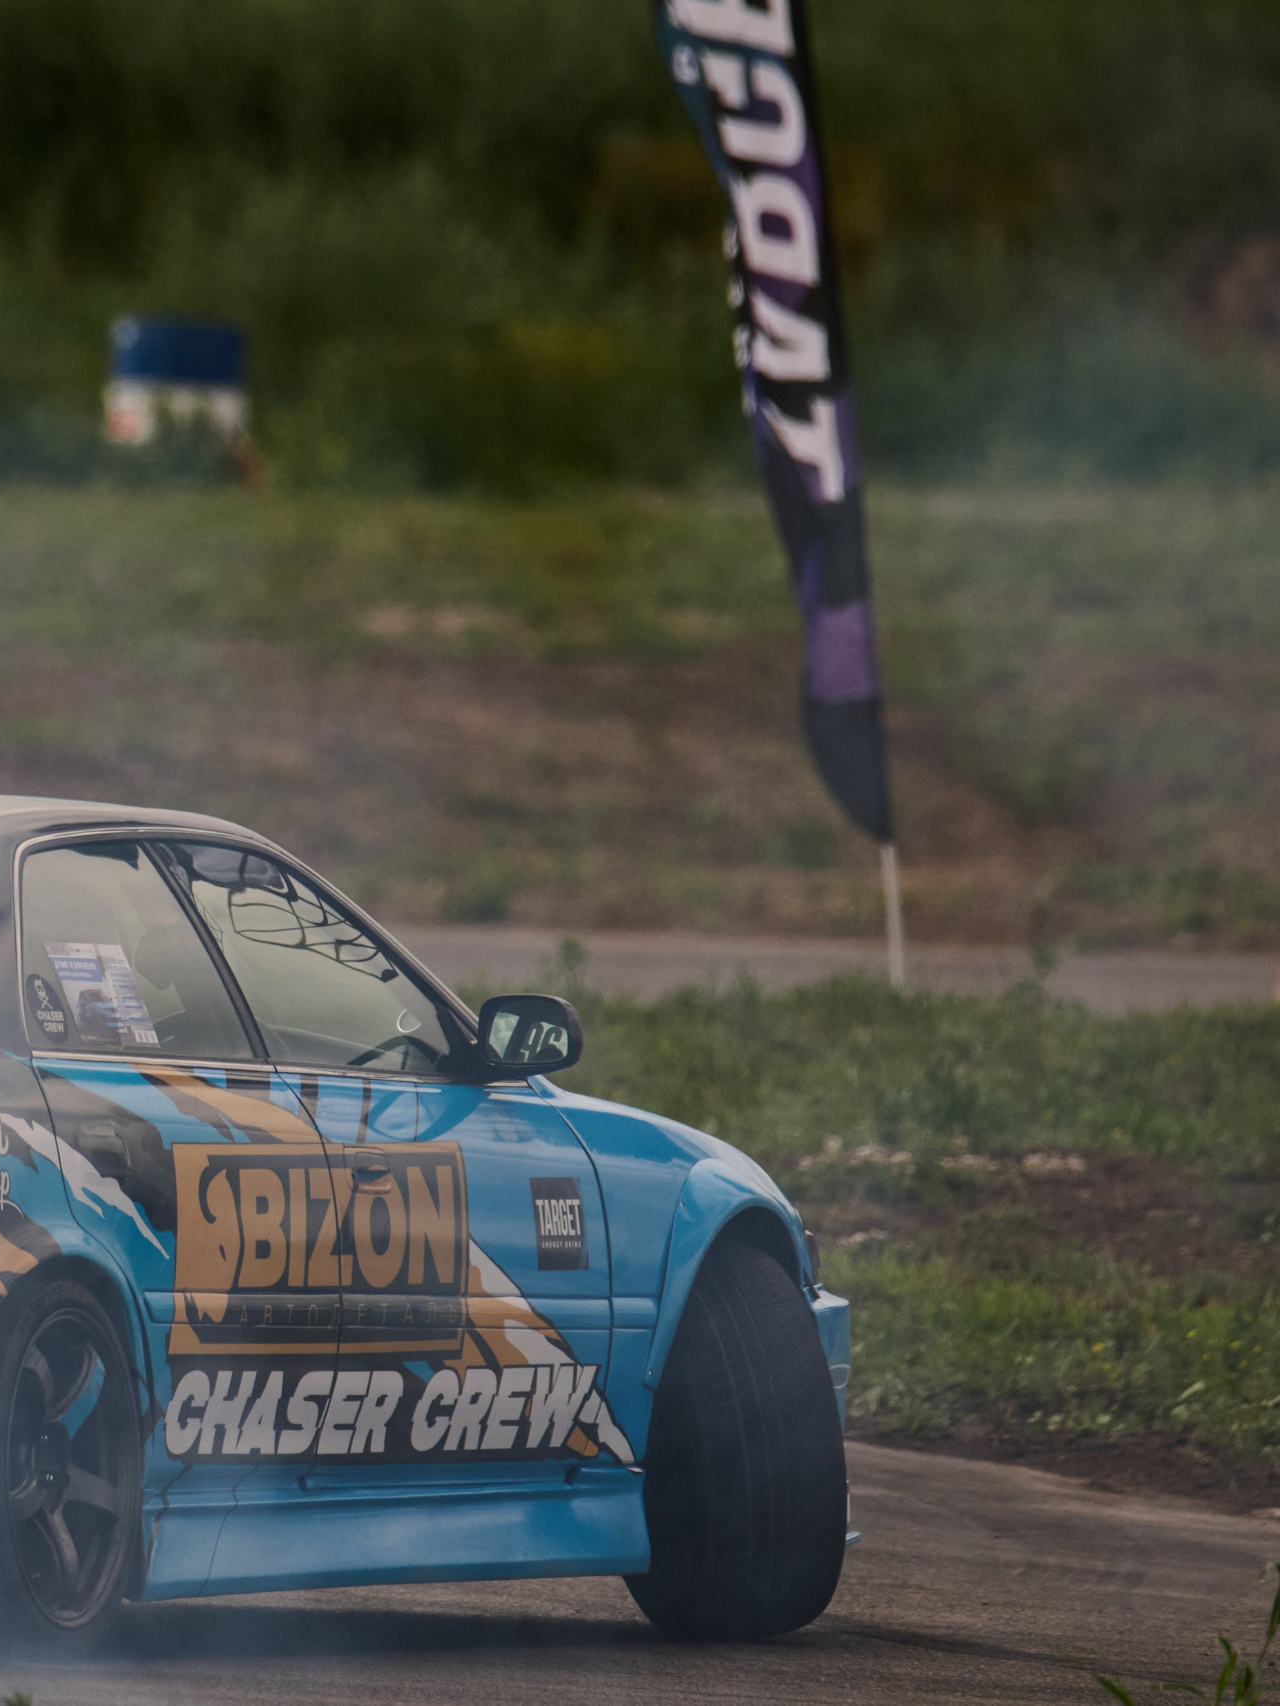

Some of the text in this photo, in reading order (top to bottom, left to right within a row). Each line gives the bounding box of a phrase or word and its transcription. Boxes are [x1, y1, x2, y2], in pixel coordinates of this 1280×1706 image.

[37, 1010, 64, 1021] CHASER
[44, 1021, 64, 1032] CREW
[237, 1165, 455, 1288] BIZON
[535, 1199, 581, 1236] TARGET
[541, 1240, 582, 1249] ENERGY DRINK
[164, 1364, 598, 1456] CHASER CREW
